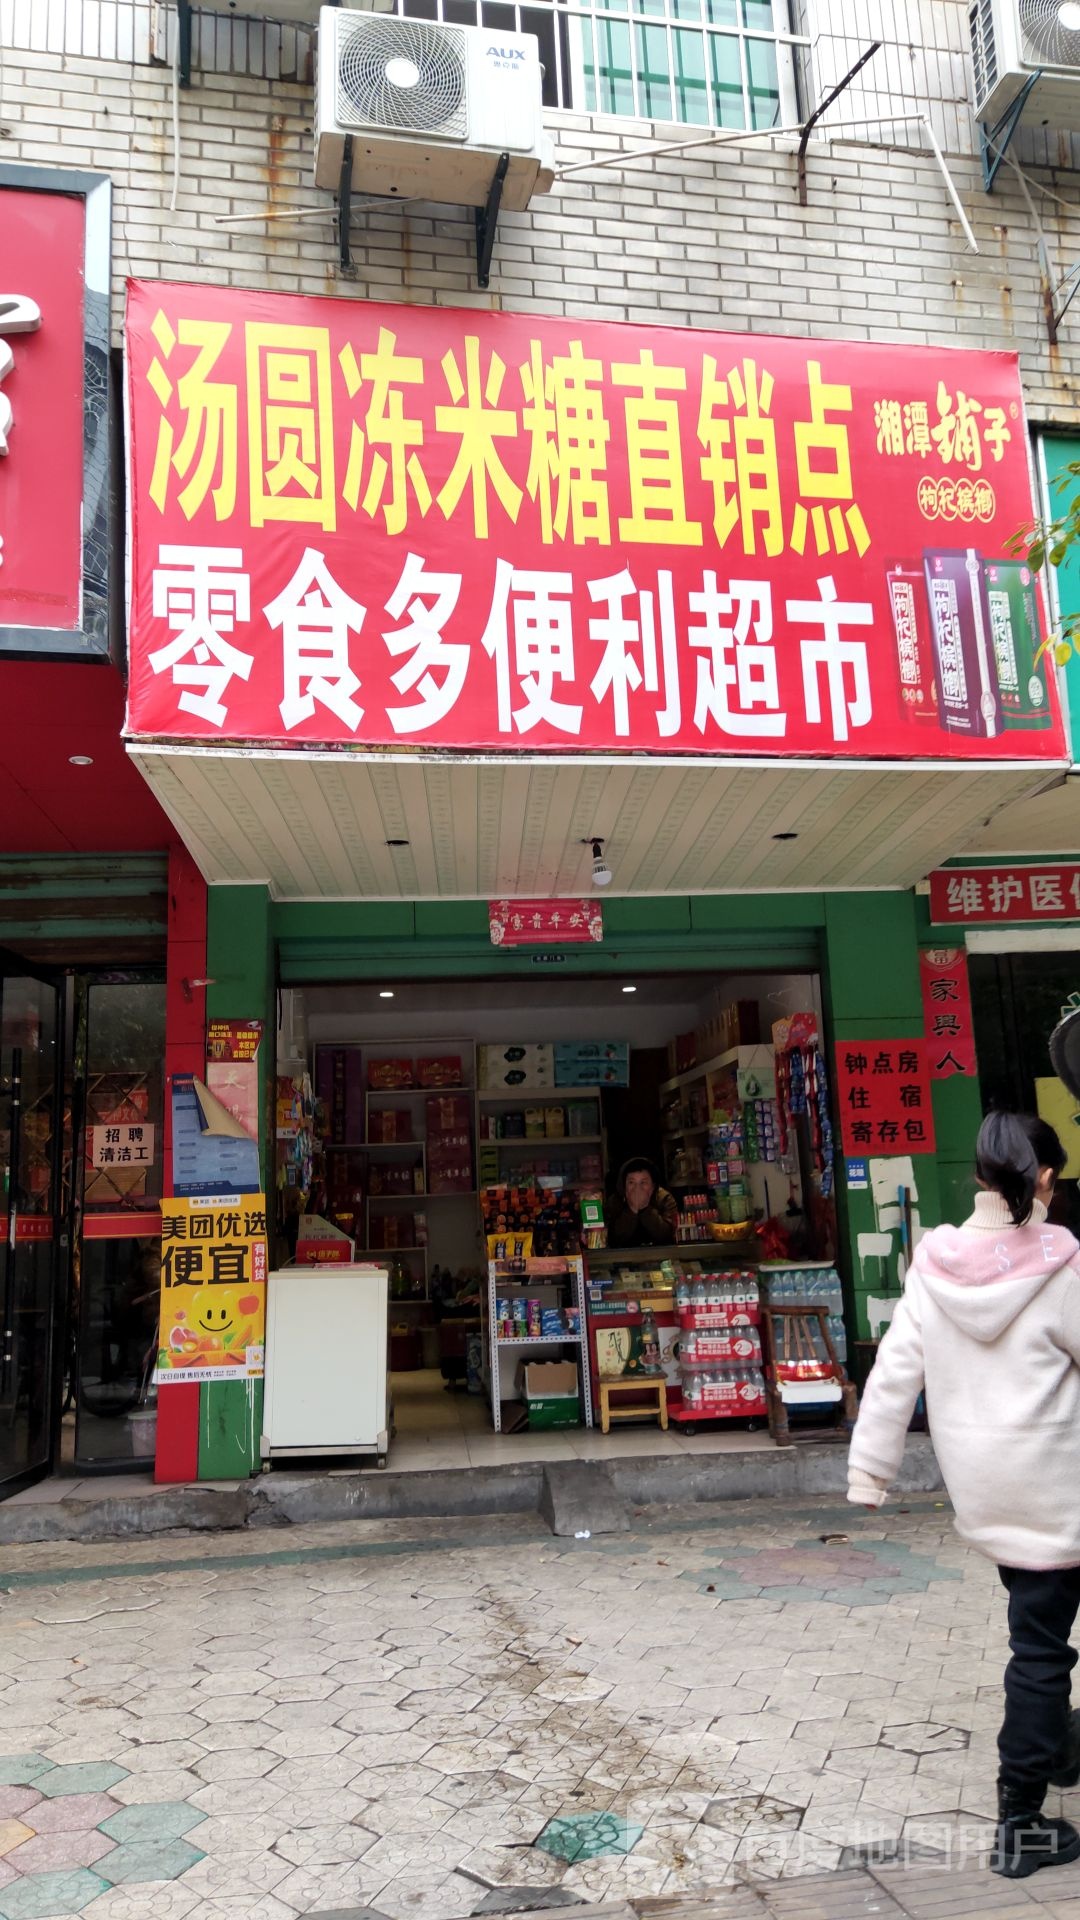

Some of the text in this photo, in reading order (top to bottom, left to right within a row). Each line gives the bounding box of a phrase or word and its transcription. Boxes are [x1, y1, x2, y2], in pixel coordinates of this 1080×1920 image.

[486, 47, 526, 61] AUX
[146, 307, 872, 560] 汤圆冻米糖直销点
[874, 380, 1012, 471] 湘潭铺子
[919, 480, 995, 520] 枸杞槟榔
[148, 544, 874, 742] 零食多便利超市
[845, 1051, 918, 1075] 钟点房
[848, 1085, 922, 1110] 住宿
[105, 1128, 144, 1143] 招聘
[851, 1120, 927, 1144] 寄存包
[100, 1147, 149, 1162] 清洁工
[162, 1211, 266, 1241] 美团优选
[161, 1243, 250, 1288] 便宜
[254, 1243, 266, 1281] 有好货
